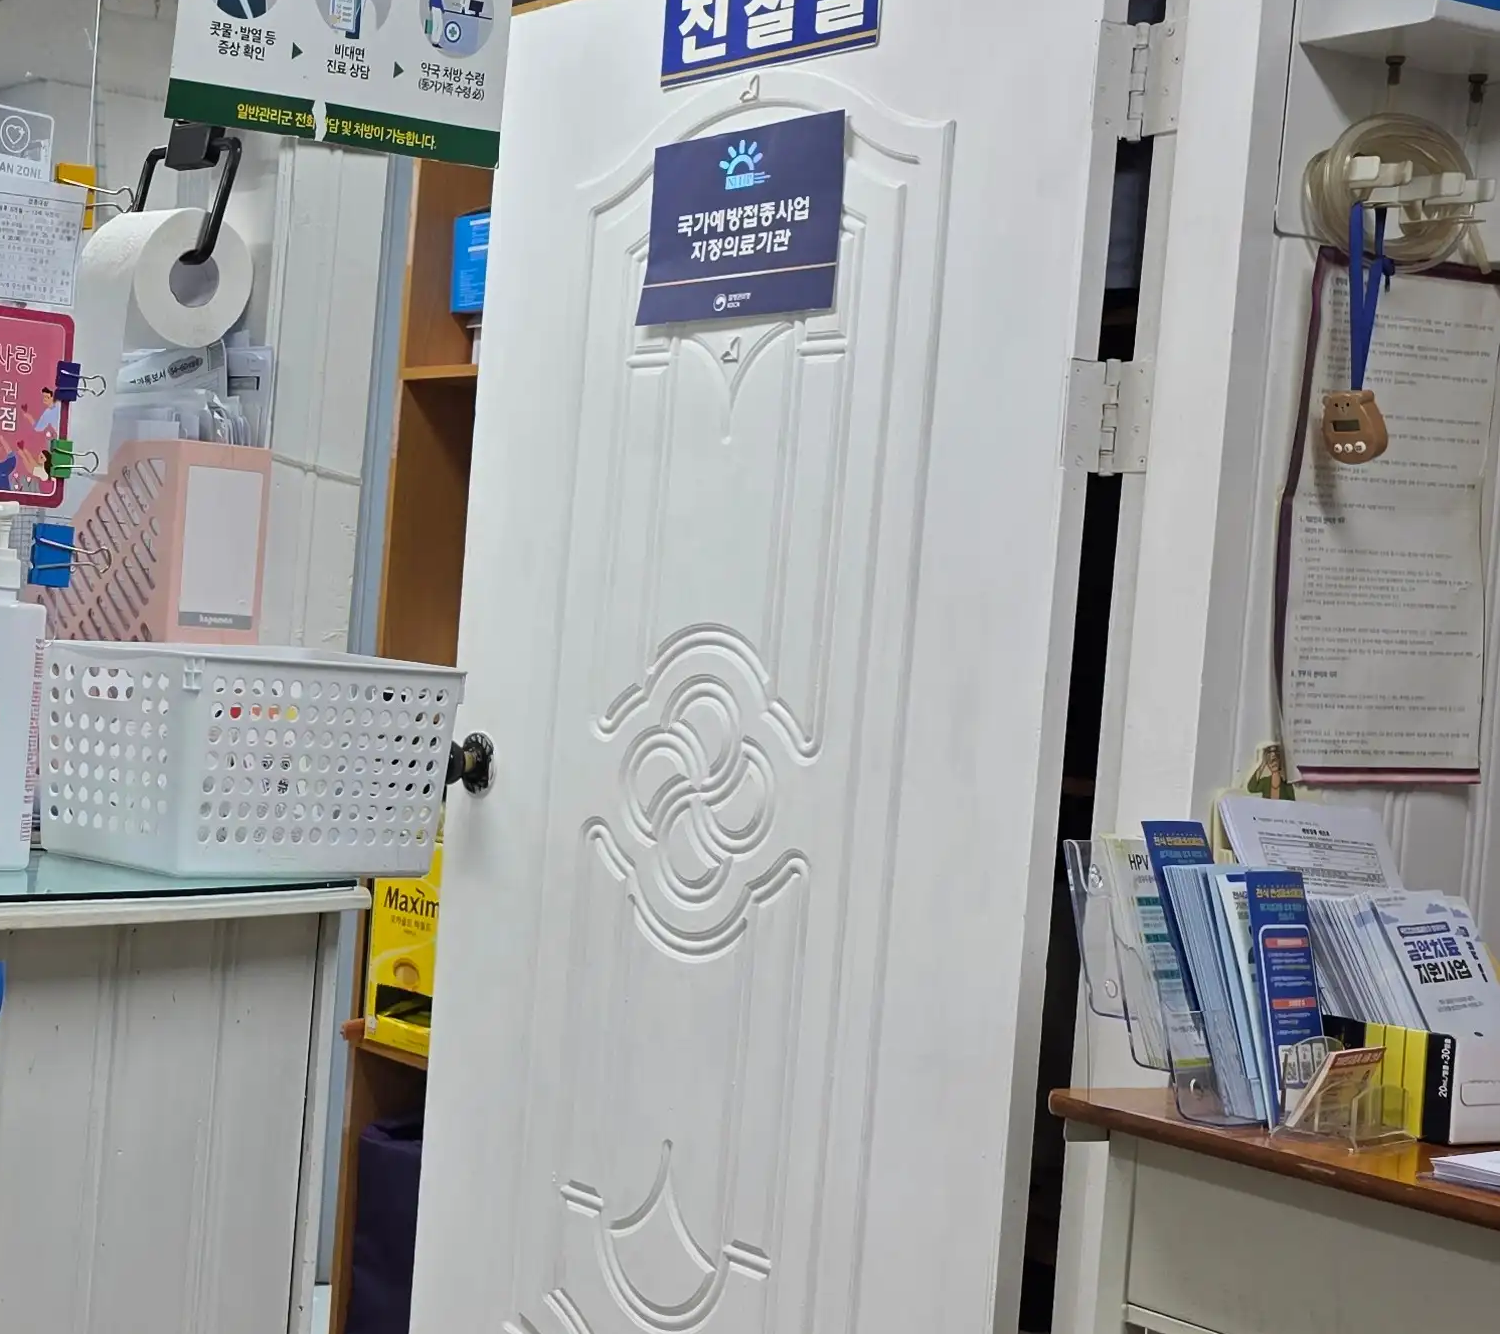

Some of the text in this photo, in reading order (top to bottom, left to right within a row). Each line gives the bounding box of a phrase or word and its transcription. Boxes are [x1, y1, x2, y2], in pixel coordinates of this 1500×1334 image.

[217, 41, 265, 60] 증상 확인
[334, 45, 365, 62] 비대면
[326, 60, 370, 80] 진료 상담
[420, 63, 485, 86] 약국 처방 수령
[237, 103, 437, 149] 일반관리군 및 처방이 가능합니다.
[678, 196, 810, 237] 국가예방접종사업
[691, 229, 791, 262] 지정의료기관
[384, 886, 440, 918] Maxim
[1404, 937, 1461, 962] 금연치료
[1413, 960, 1472, 984] 지원사업
